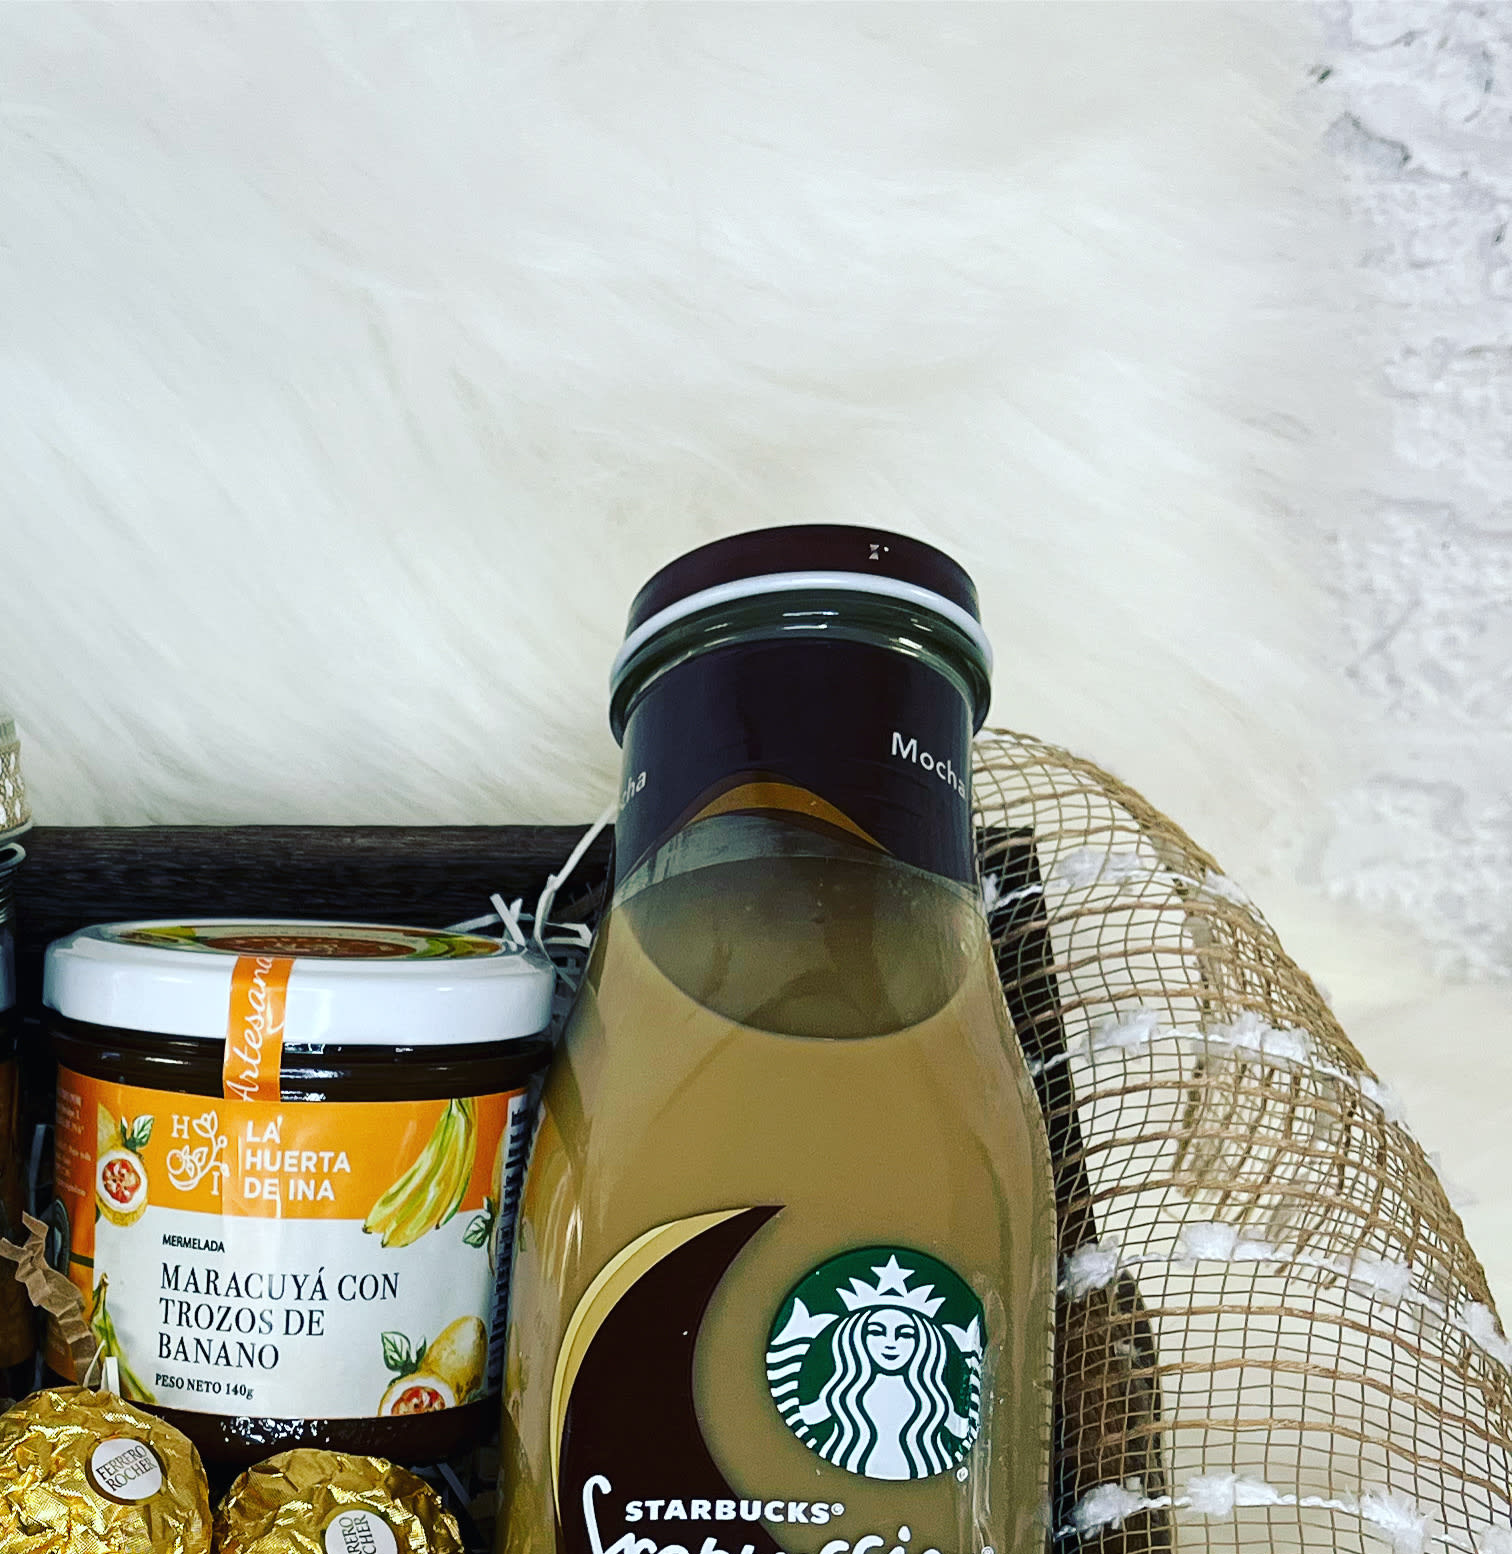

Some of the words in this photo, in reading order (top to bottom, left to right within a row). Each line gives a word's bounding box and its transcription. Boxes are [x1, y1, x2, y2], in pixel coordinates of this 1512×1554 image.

[891, 731, 966, 800] Mocha
[245, 1148, 352, 1173] HUERTA
[243, 1177, 279, 1200] DE
[288, 1178, 336, 1201] INA
[162, 1233, 226, 1253] MERMELADA
[160, 1262, 330, 1302] MARACUYÁ
[338, 1272, 400, 1302] CON
[159, 1297, 273, 1336] TROZOS
[283, 1308, 326, 1337] DE
[158, 1331, 279, 1371] BANANO
[155, 1372, 184, 1390] PESO
[187, 1377, 222, 1395] NETO
[225, 1383, 255, 1400] 140g
[95, 1445, 147, 1481] FERRERO
[105, 1457, 158, 1492] ROCHER
[625, 1500, 830, 1524] STARBUCKS
